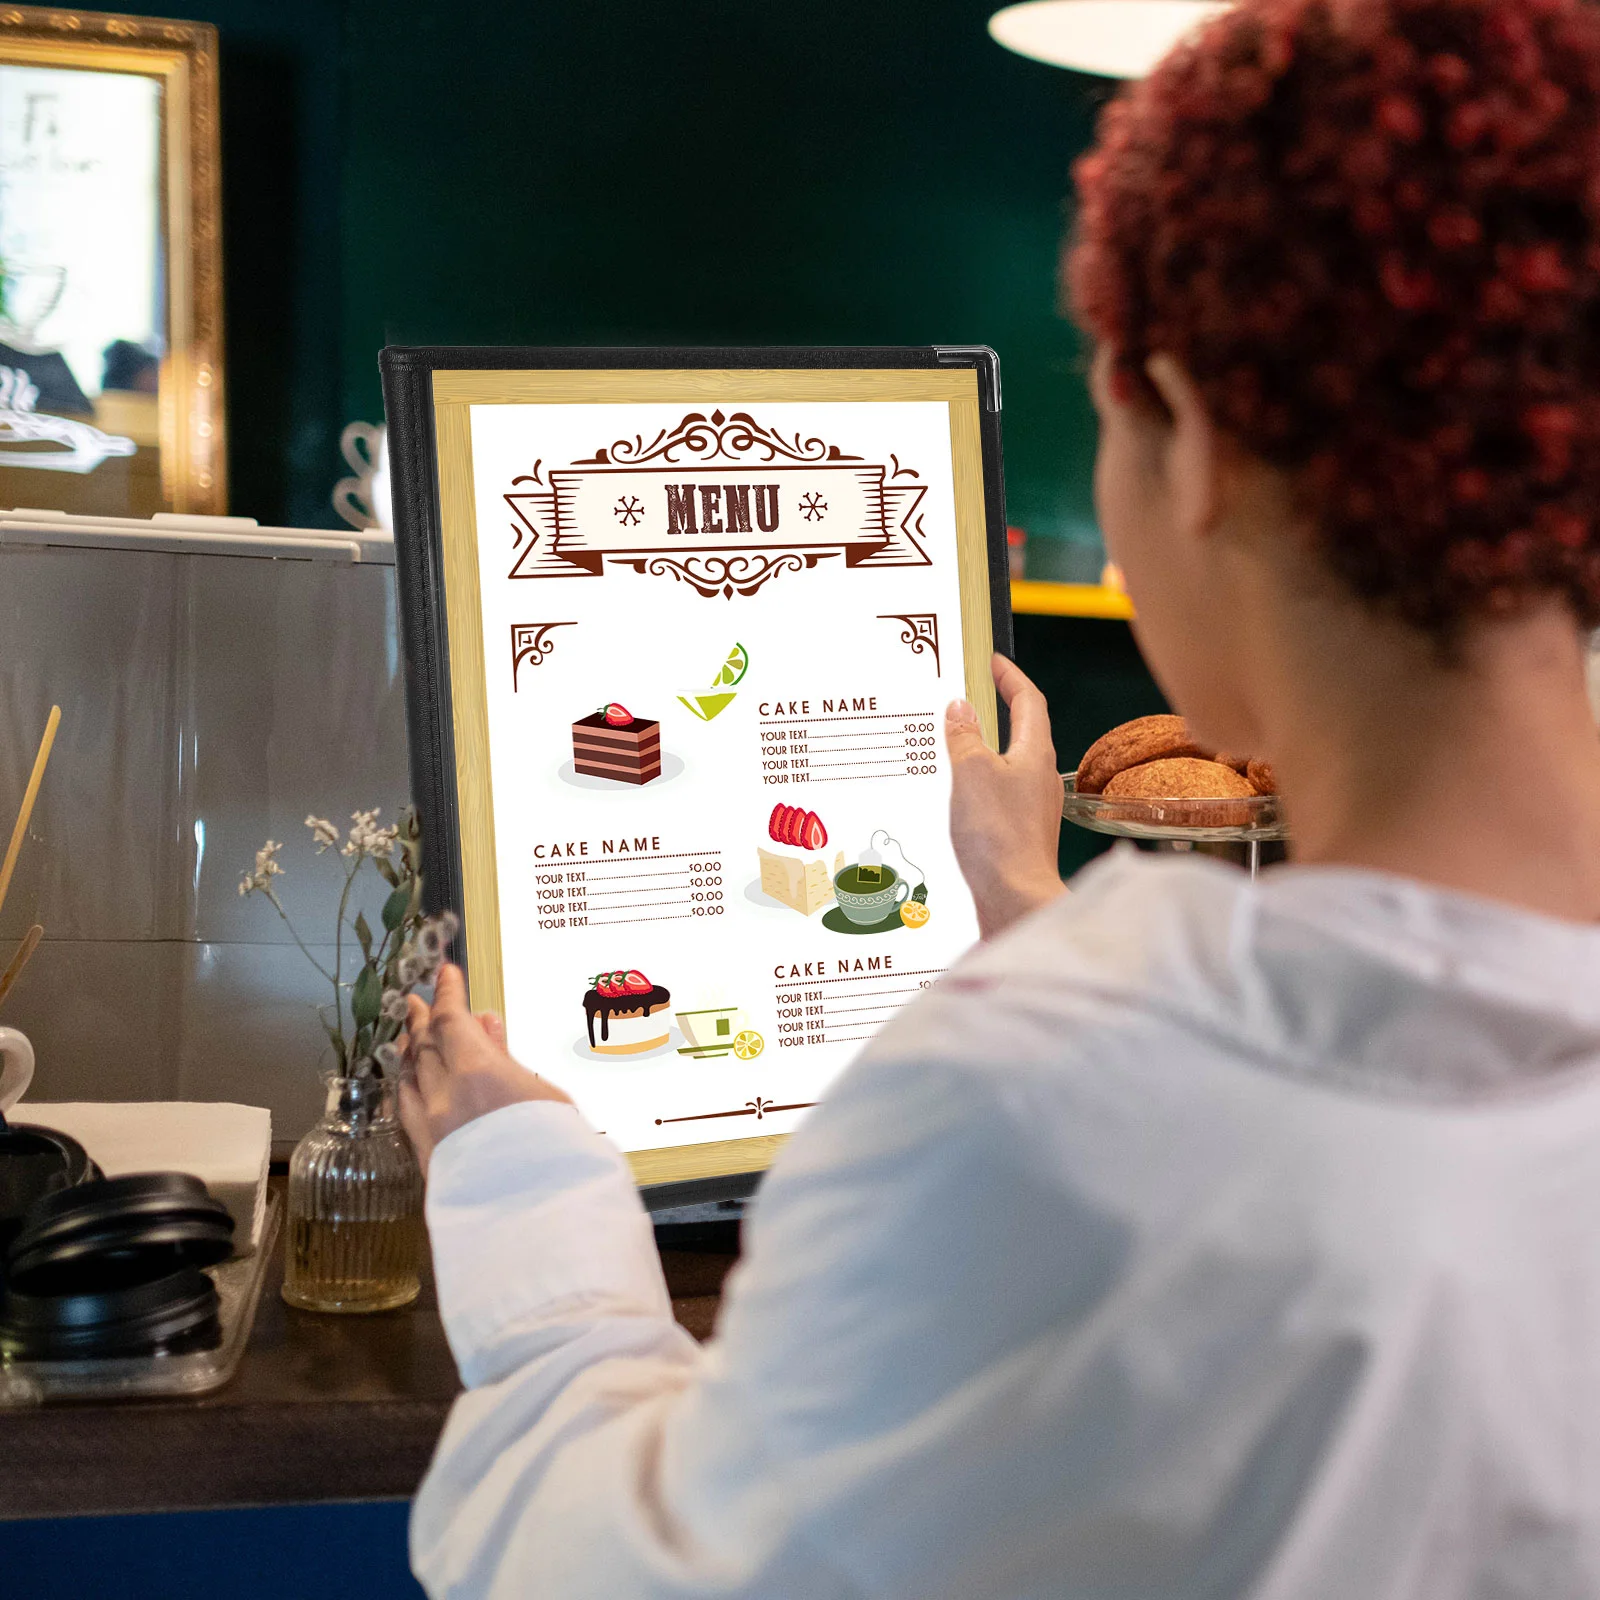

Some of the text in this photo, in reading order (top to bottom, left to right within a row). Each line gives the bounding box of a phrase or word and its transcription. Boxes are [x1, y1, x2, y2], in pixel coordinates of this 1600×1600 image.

[664, 483, 781, 535] MENU
[758, 696, 878, 716] CAKE NAME
[760, 731, 787, 741] YOUR
[788, 729, 808, 739] TEXT
[761, 745, 788, 755] YOUR
[789, 743, 809, 753] TEXT
[762, 759, 789, 770] YOUR
[790, 758, 810, 768] TEXT
[762, 773, 790, 784] YOUR
[791, 772, 811, 782] TEXT
[533, 836, 661, 858] CAKE NAME
[535, 873, 564, 884] YOUR
[566, 871, 586, 882] TEXT
[535, 888, 565, 899] YOUR
[566, 886, 587, 897] TEXT
[536, 903, 566, 914] YOUR
[567, 901, 588, 912] TEXT
[537, 918, 567, 929] YOUR
[568, 916, 589, 927] TEXT
[774, 955, 893, 978] CAKE NAME
[775, 993, 802, 1004] YOUR
[804, 990, 823, 1001] TEXT
[776, 1005, 824, 1018] YOUR TEXT
[777, 1019, 825, 1032] YOUR TEXT
[778, 1033, 826, 1047] YOUR TEXT
